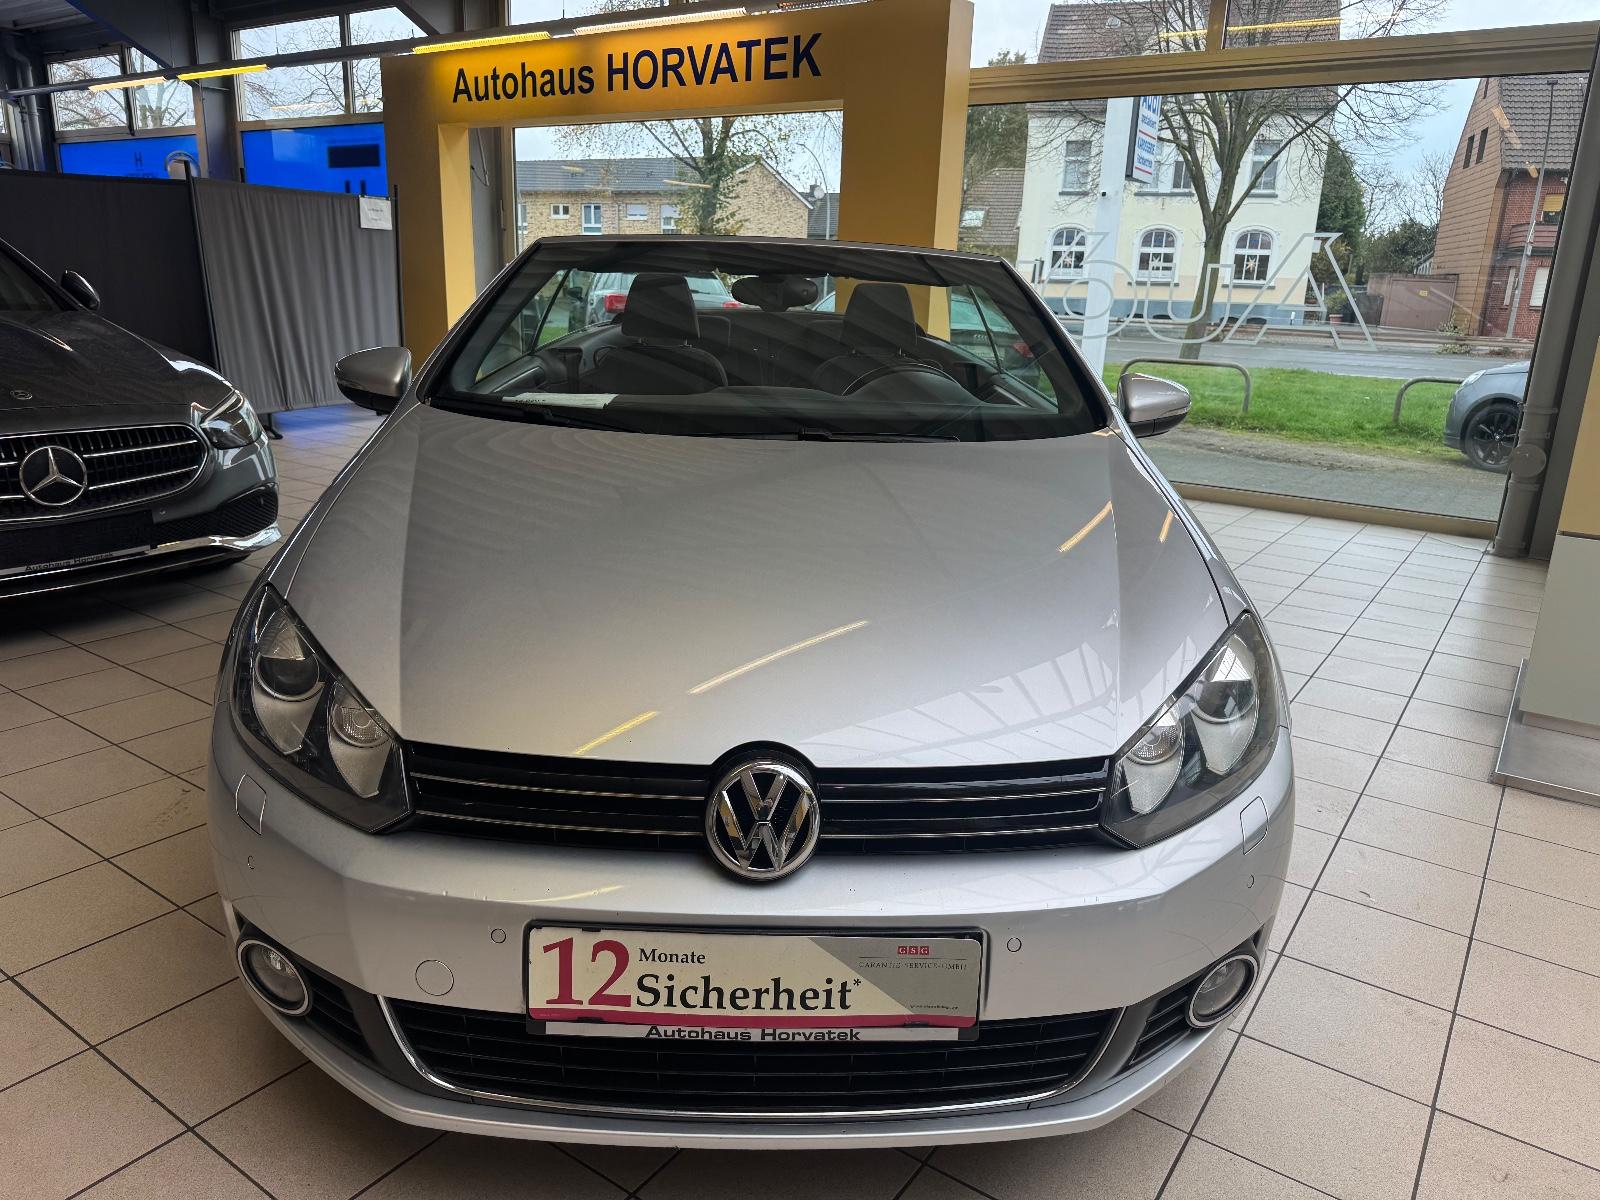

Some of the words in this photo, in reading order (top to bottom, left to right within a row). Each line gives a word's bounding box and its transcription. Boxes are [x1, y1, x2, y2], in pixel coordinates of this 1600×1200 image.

[452, 62, 594, 103] Autohaus
[607, 32, 823, 91] HORVATEK
[639, 948, 706, 964] Monate
[898, 946, 930, 955] GSG
[543, 937, 632, 1007] 12
[645, 1025, 752, 1040] Autohaus
[760, 1028, 861, 1041] Horvatek
